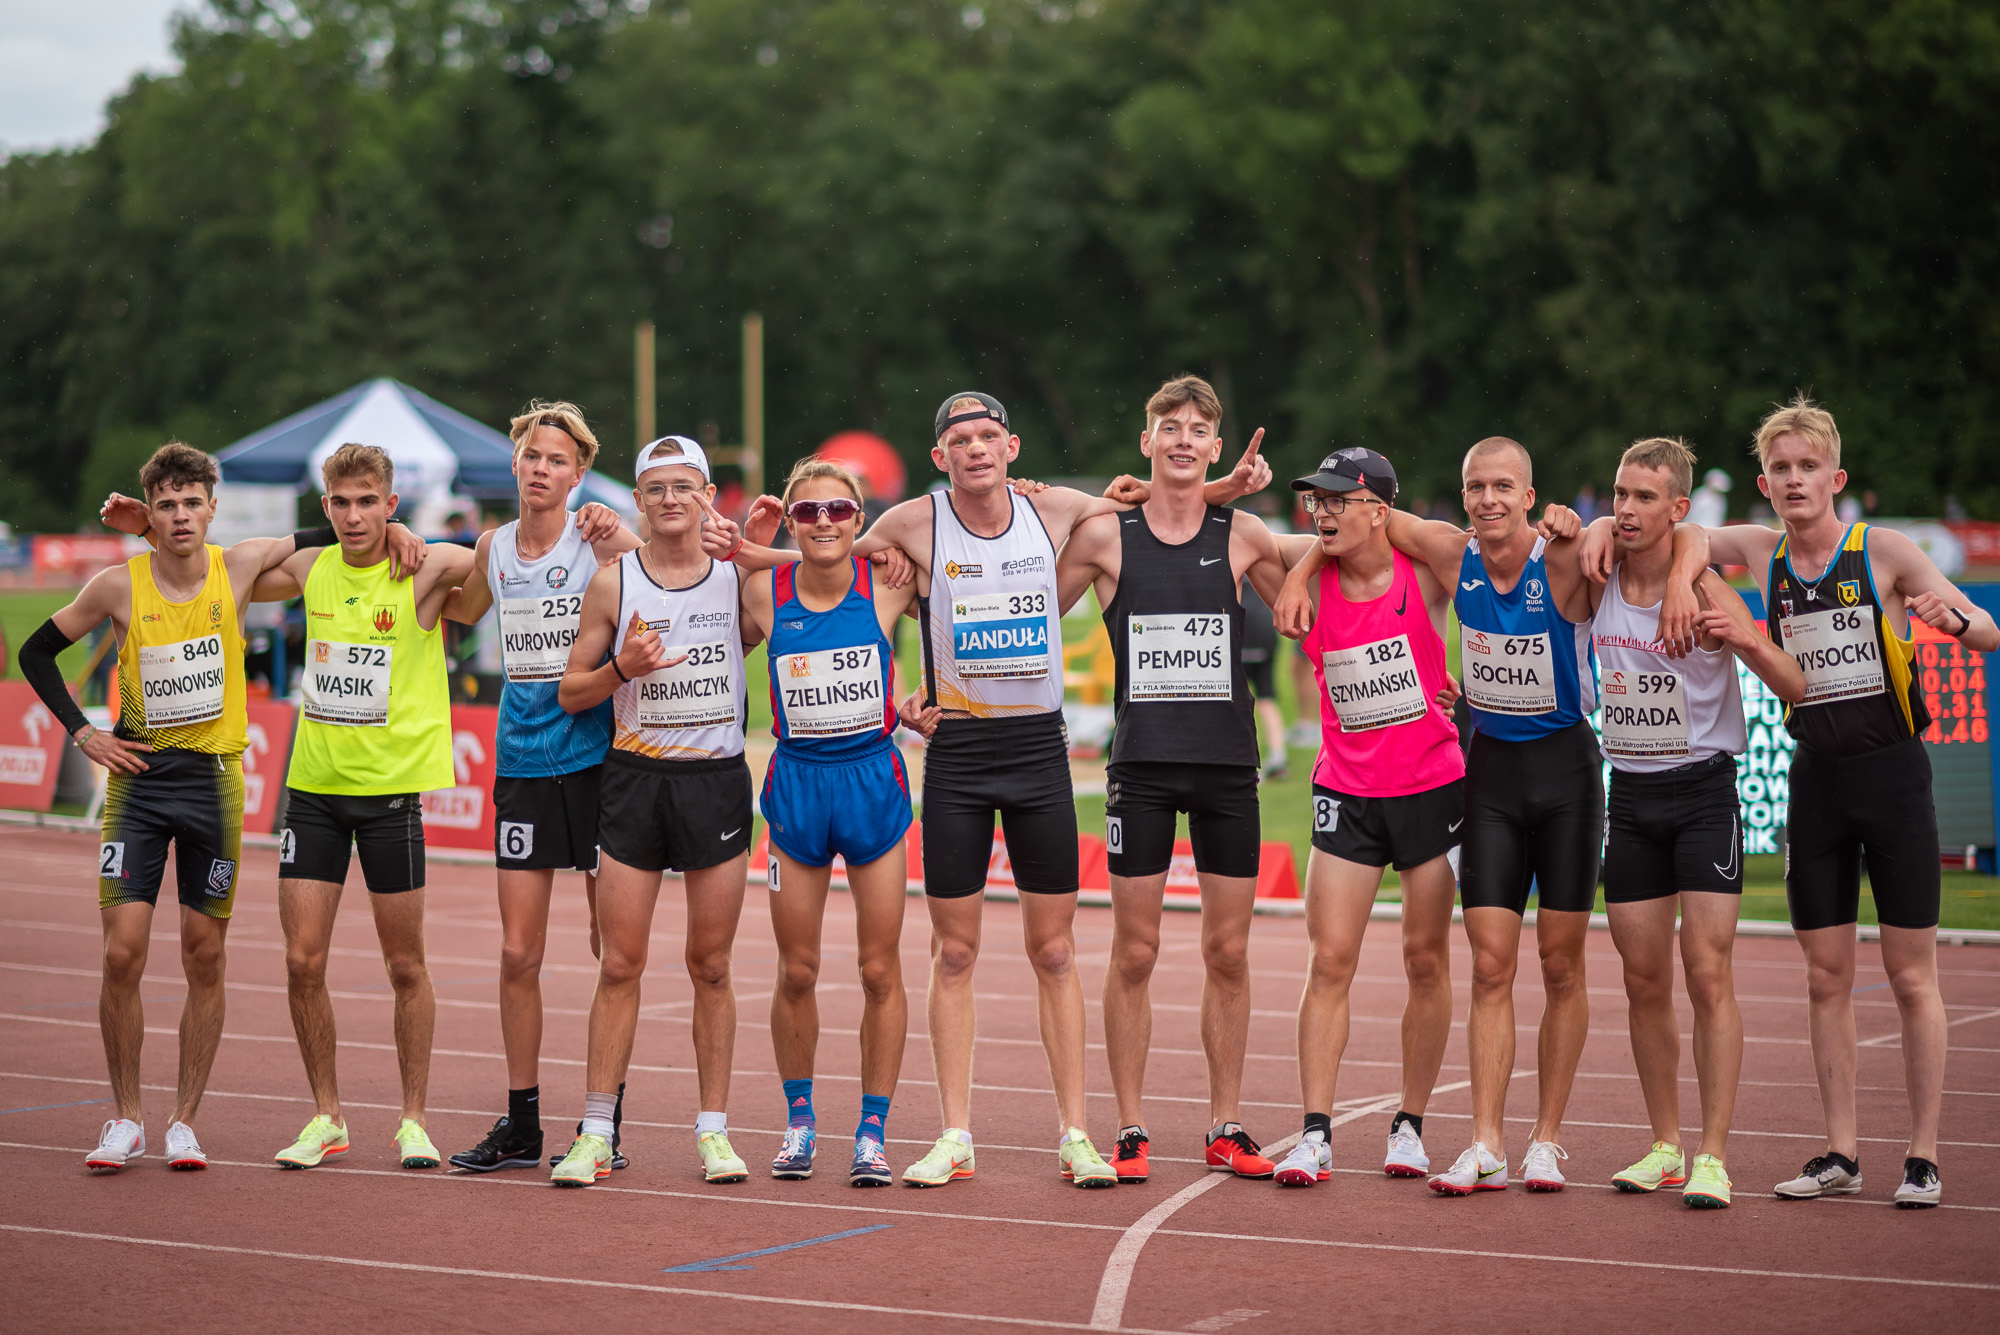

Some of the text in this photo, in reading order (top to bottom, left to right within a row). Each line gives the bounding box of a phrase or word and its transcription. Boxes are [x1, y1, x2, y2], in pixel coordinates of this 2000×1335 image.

[345, 597, 359, 605] 4F
[542, 597, 581, 618] 252
[1008, 594, 1045, 615] 333
[648, 620, 669, 629] OPTIMA
[1184, 618, 1224, 636] 473
[1832, 610, 1861, 631] 86
[505, 628, 579, 652] KUROWSK
[959, 626, 1047, 651] JANDUŁA
[1468, 641, 1490, 654] ORLEN
[1504, 637, 1544, 655] 675
[183, 638, 219, 661] 840
[348, 647, 386, 666] 572
[688, 644, 726, 666] 325
[833, 649, 871, 671] 587
[1138, 646, 1222, 669] PEMPUŚ
[1365, 640, 1406, 665] 182
[1796, 642, 1877, 672] WYSOCKI
[1328, 659, 1357, 668] MAŁOPOLSKA
[1472, 662, 1540, 686] SOCHA
[144, 667, 224, 698] OGONOWSKI
[316, 674, 373, 698] WĄSIK
[640, 675, 730, 700] ABRAMCZYK
[1331, 669, 1417, 704] SZYMAŃSKI
[1607, 685, 1626, 693] ORLEN
[1638, 675, 1676, 694] 599
[1815, 681, 1847, 693] Mistrzostwa
[1849, 678, 1868, 687] Polski
[1918, 667, 1986, 693] 0.04
[786, 680, 880, 708] ZIELIŃSKI
[1473, 693, 1484, 701] PZLA
[1486, 696, 1521, 705] Mistrzostwa
[170, 706, 205, 716] Mistrzostwa
[322, 708, 354, 716] Mistrzostwa
[667, 713, 704, 721] Mistrzostwa
[705, 710, 722, 718] Polski
[724, 708, 734, 716] U18
[815, 718, 851, 727] Mistrzostwa
[853, 715, 870, 723] Polski
[871, 712, 882, 720] U18
[1359, 711, 1393, 722] Mistrzostwa
[1394, 706, 1412, 714] Polski
[1414, 701, 1425, 709] U18
[1605, 705, 1681, 726] PORADA
[1920, 718, 1989, 744] 4.46
[388, 798, 405, 808] 4F
[1317, 799, 1331, 828] 8
[281, 831, 290, 860] 4
[506, 826, 525, 856] 6
[102, 845, 116, 874] 2
